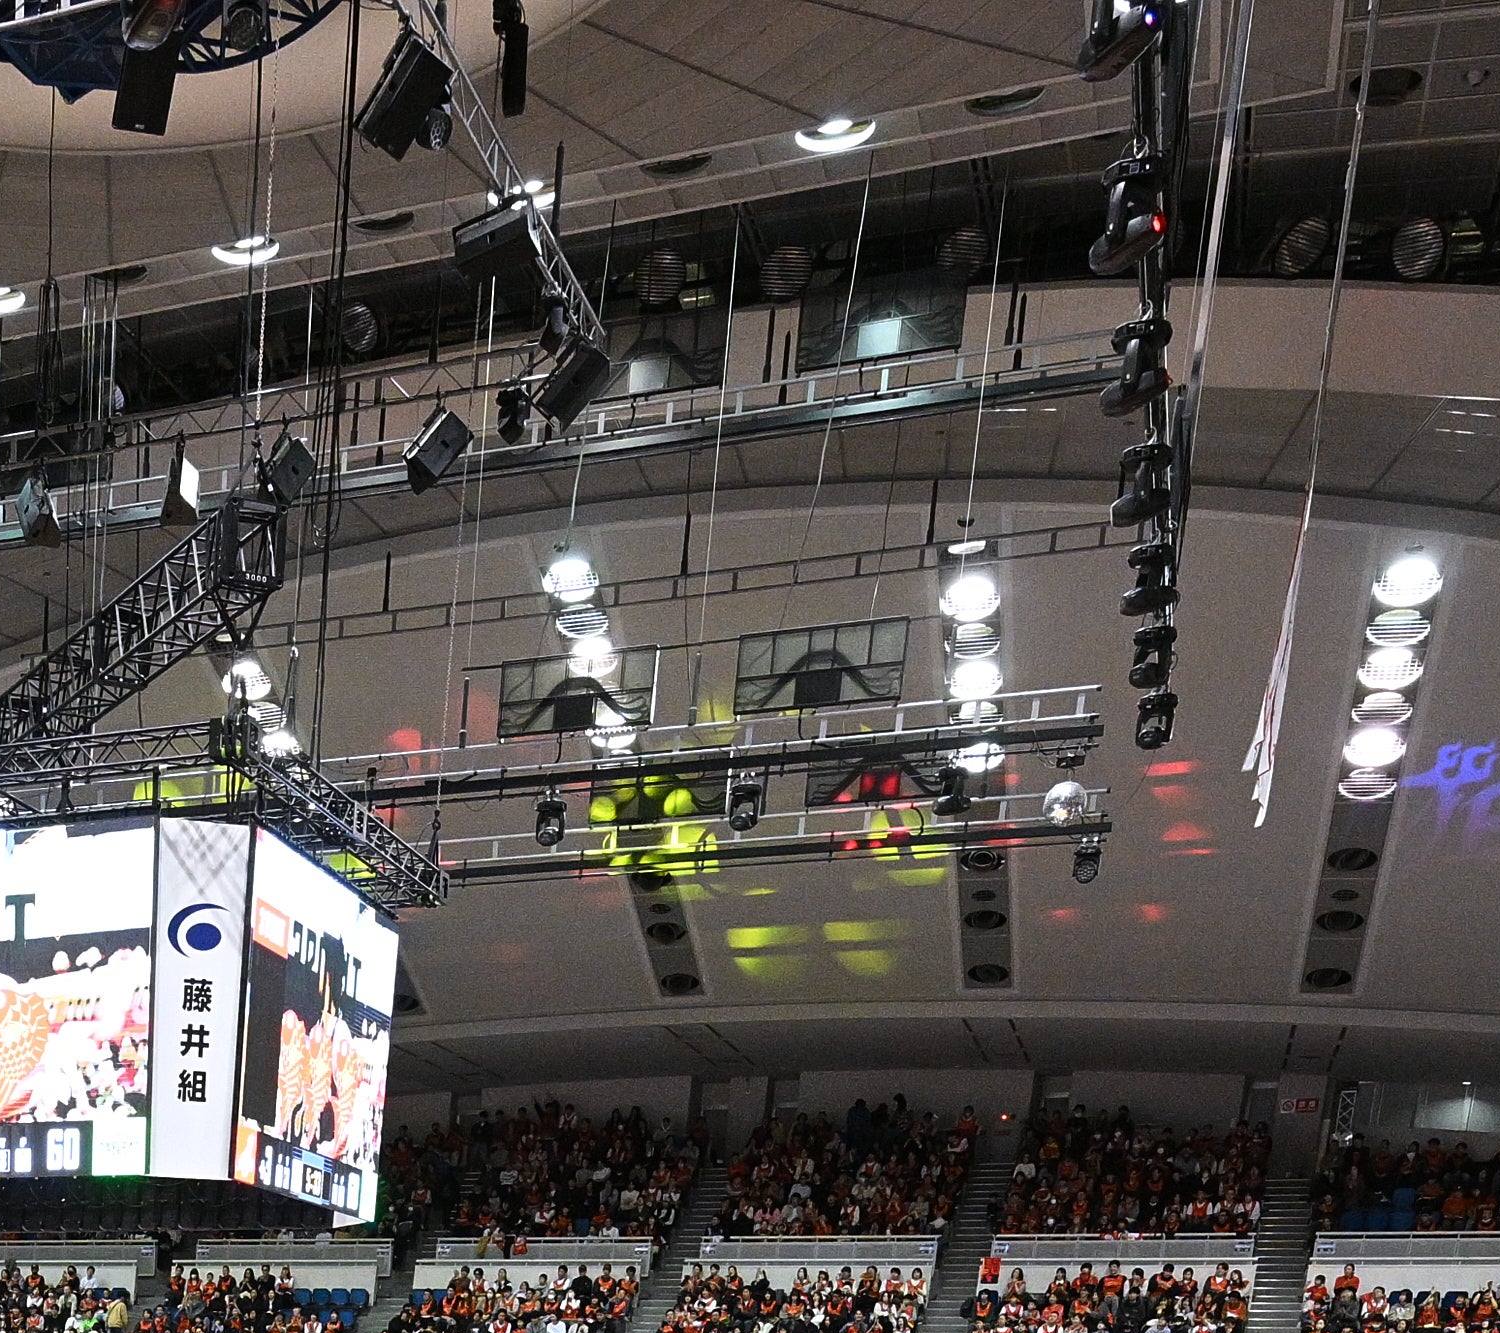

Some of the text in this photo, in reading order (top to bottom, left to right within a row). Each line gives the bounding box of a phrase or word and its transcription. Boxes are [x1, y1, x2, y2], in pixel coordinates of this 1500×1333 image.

[178, 977, 213, 1104] 藤井組
[47, 1128, 81, 1171] 60
